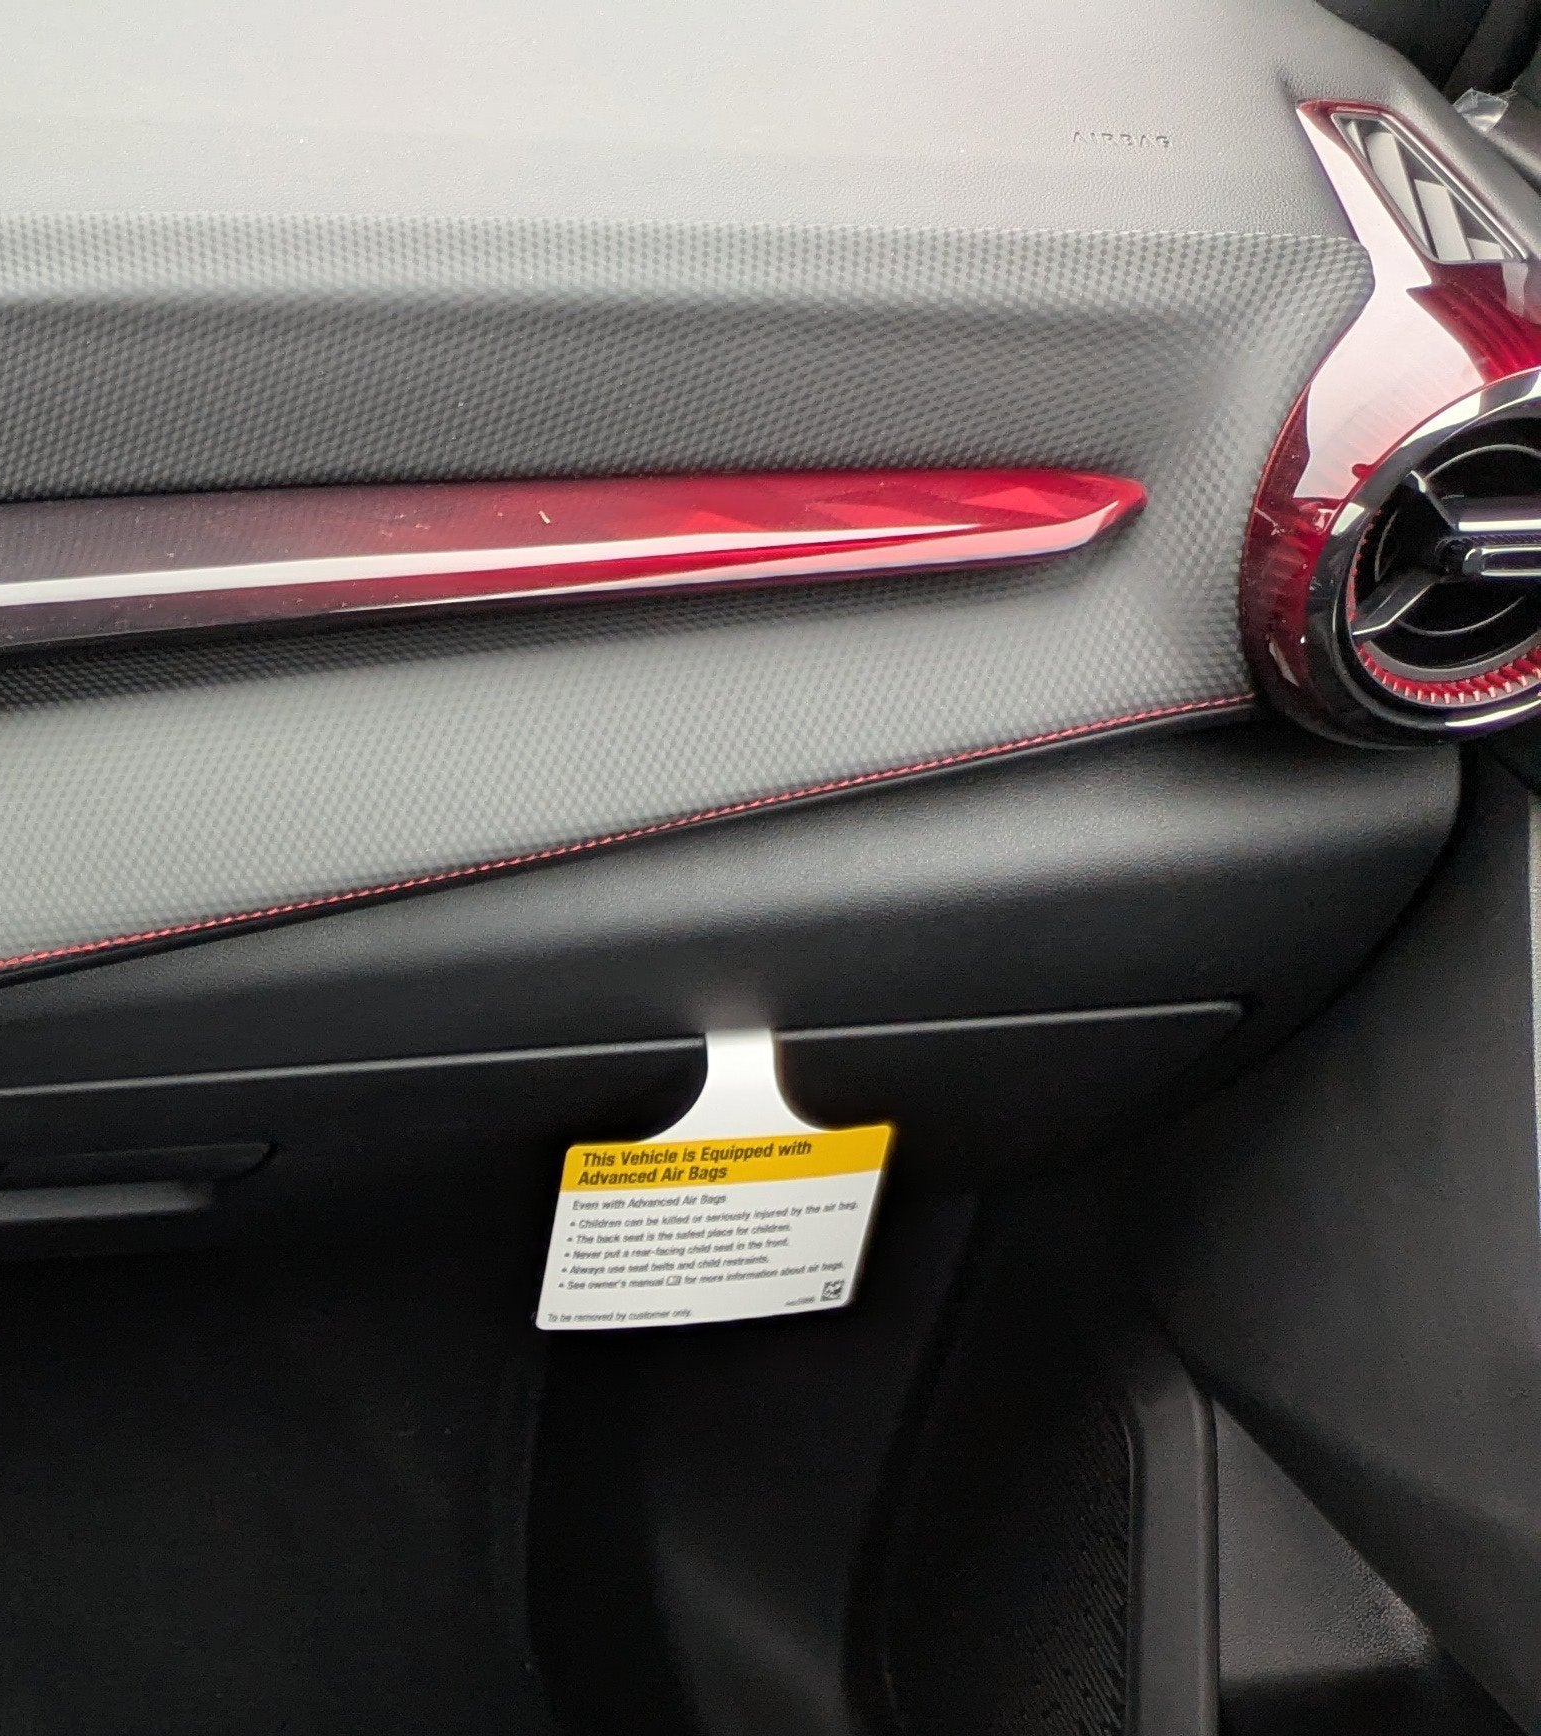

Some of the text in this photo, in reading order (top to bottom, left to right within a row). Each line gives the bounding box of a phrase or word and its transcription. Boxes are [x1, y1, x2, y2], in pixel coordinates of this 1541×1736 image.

[583, 1151, 615, 1167] This
[621, 1149, 678, 1166] Vehicle
[700, 1143, 774, 1163] Equipped
[778, 1141, 812, 1156] with
[577, 1165, 728, 1186] Advanced Air Bags
[573, 1194, 726, 1211] Even with Advanced Air Bags
[579, 1218, 621, 1229] Children
[624, 1218, 643, 1227] can
[646, 1215, 659, 1226] be
[805, 1203, 820, 1214] the
[577, 1234, 594, 1244] The
[623, 1233, 644, 1243] seat
[657, 1231, 673, 1241] the
[572, 1250, 602, 1259] Never
